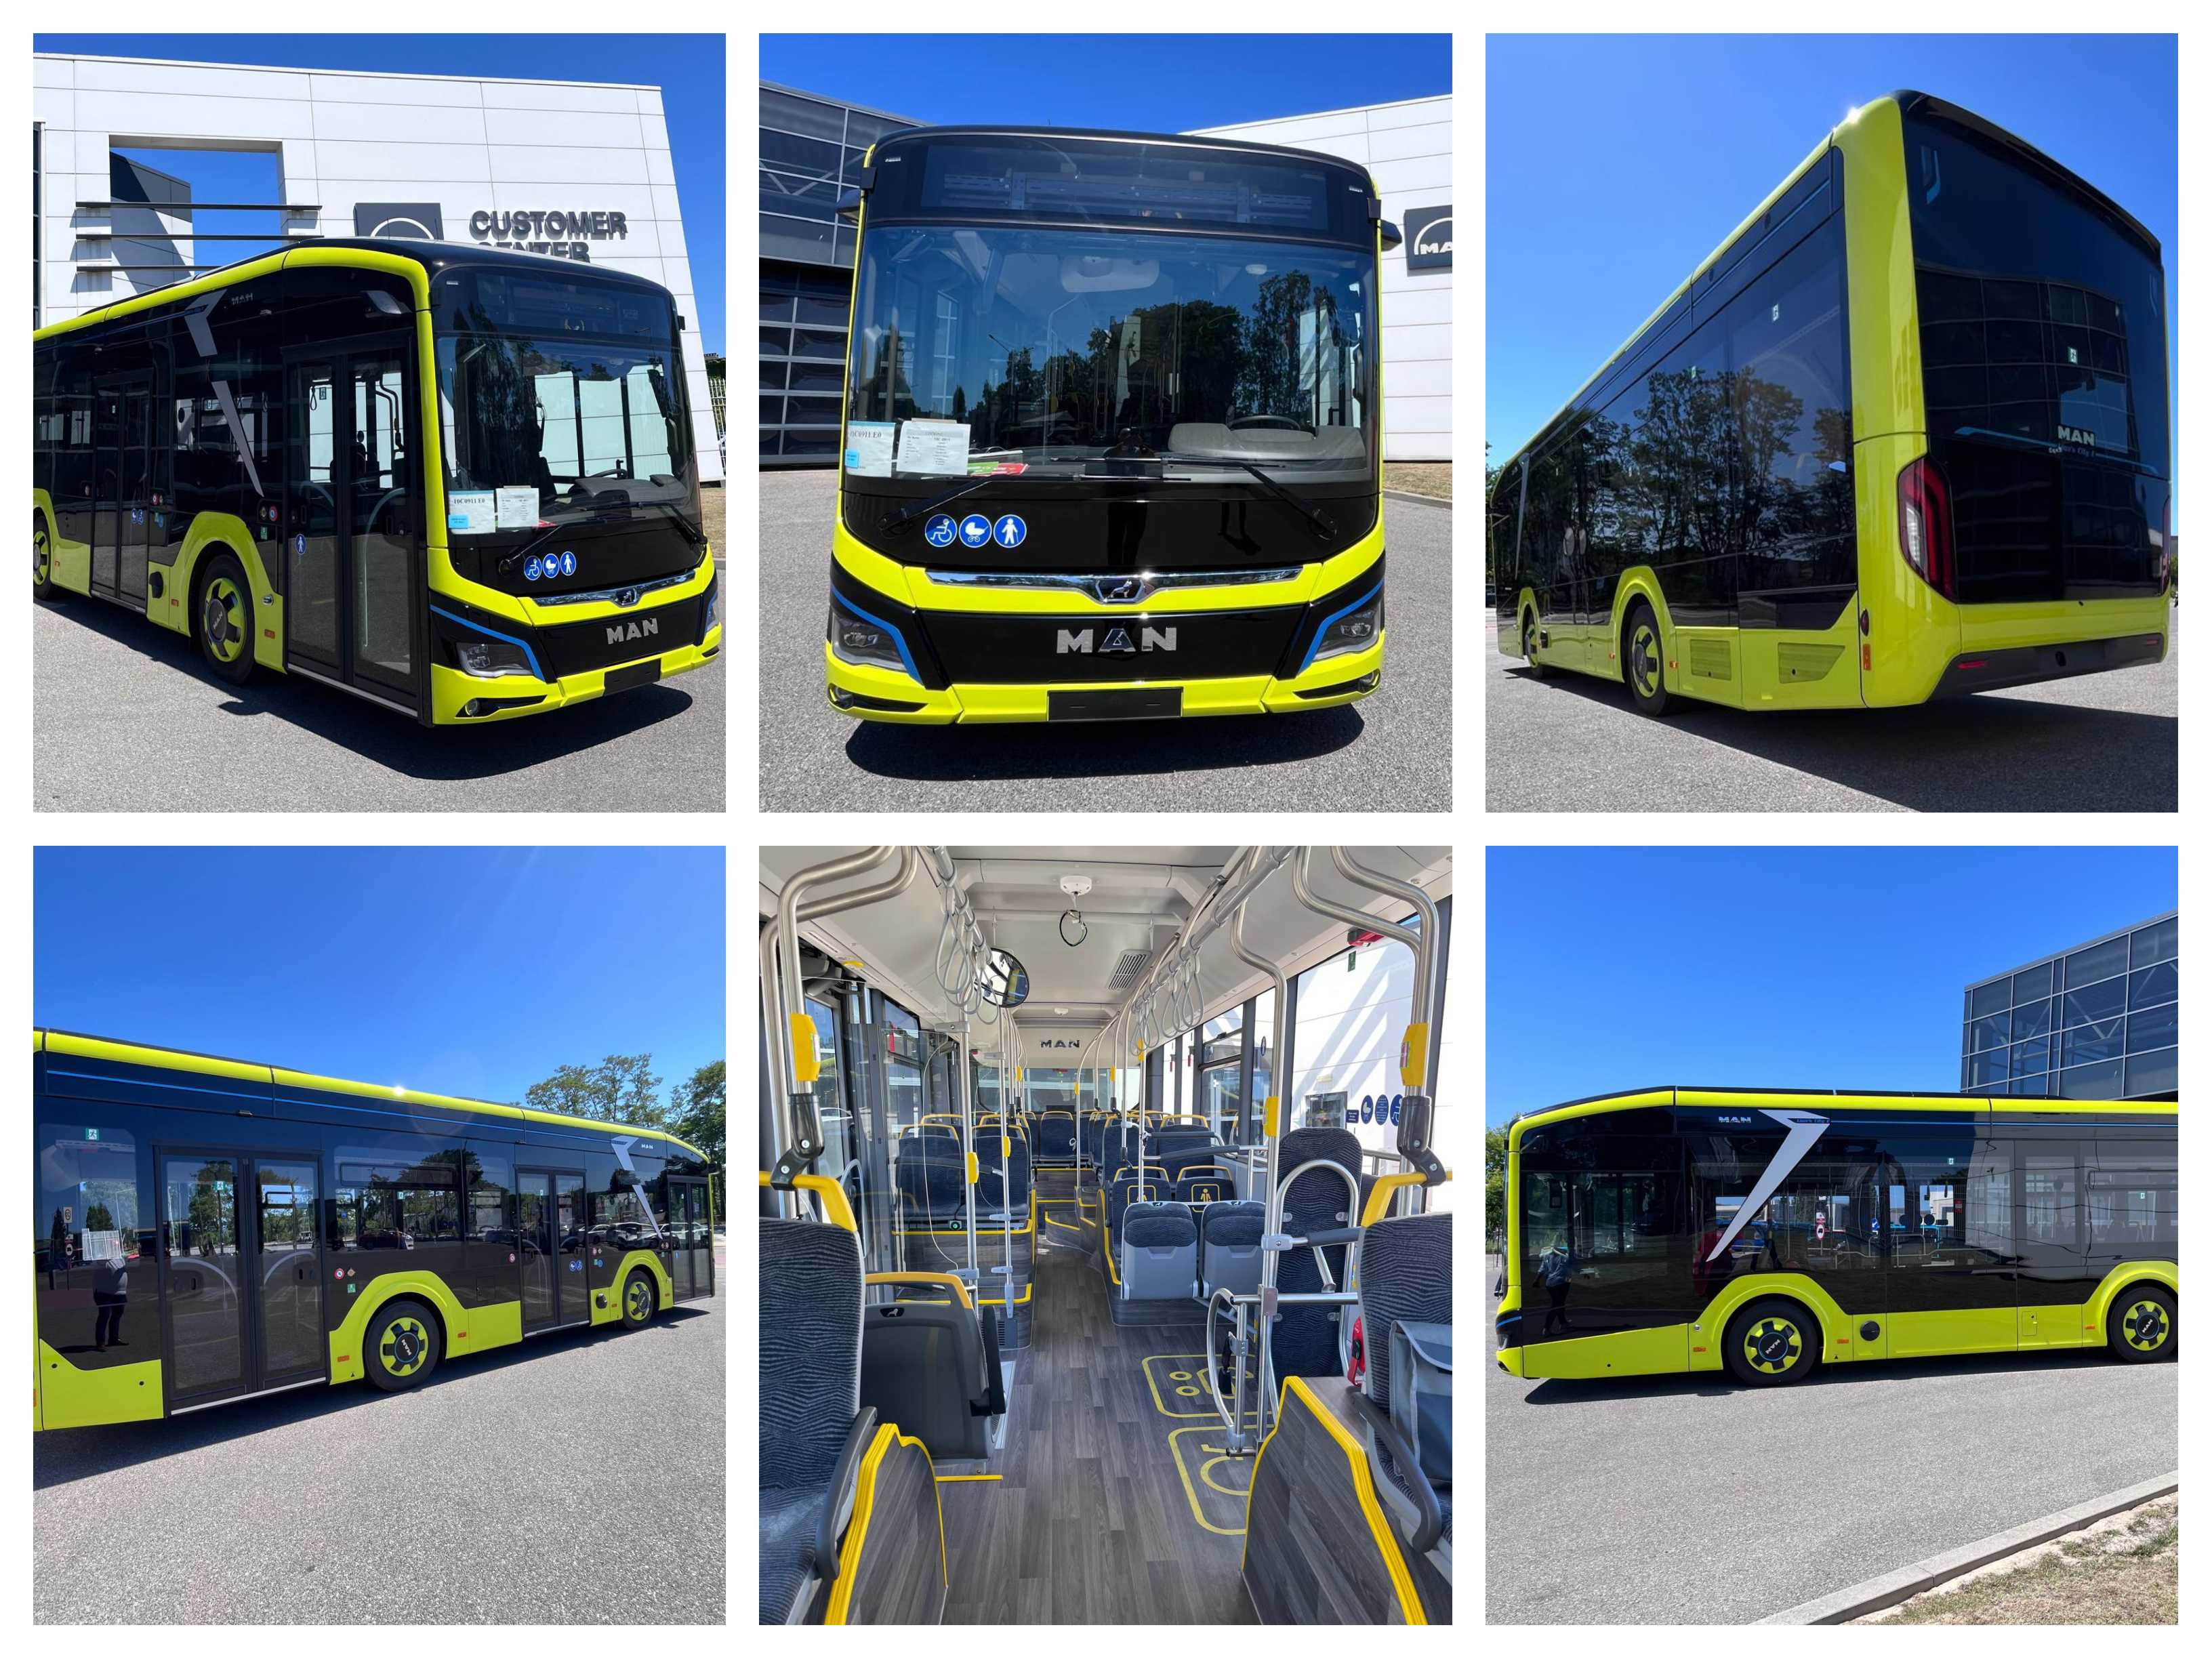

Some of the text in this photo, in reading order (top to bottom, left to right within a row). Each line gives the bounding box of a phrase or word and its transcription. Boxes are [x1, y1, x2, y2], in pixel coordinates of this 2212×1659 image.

[470, 211, 628, 239] CUSTOMER
[2057, 425, 2095, 447] MAN
[606, 617, 659, 644] MAN
[1057, 626, 1177, 653] MAN
[1040, 1040, 1080, 1048] MAN
[2142, 1319, 2153, 1333] MAN
[401, 1338, 412, 1355] MAN
[1765, 1339, 1781, 1354] MAN
